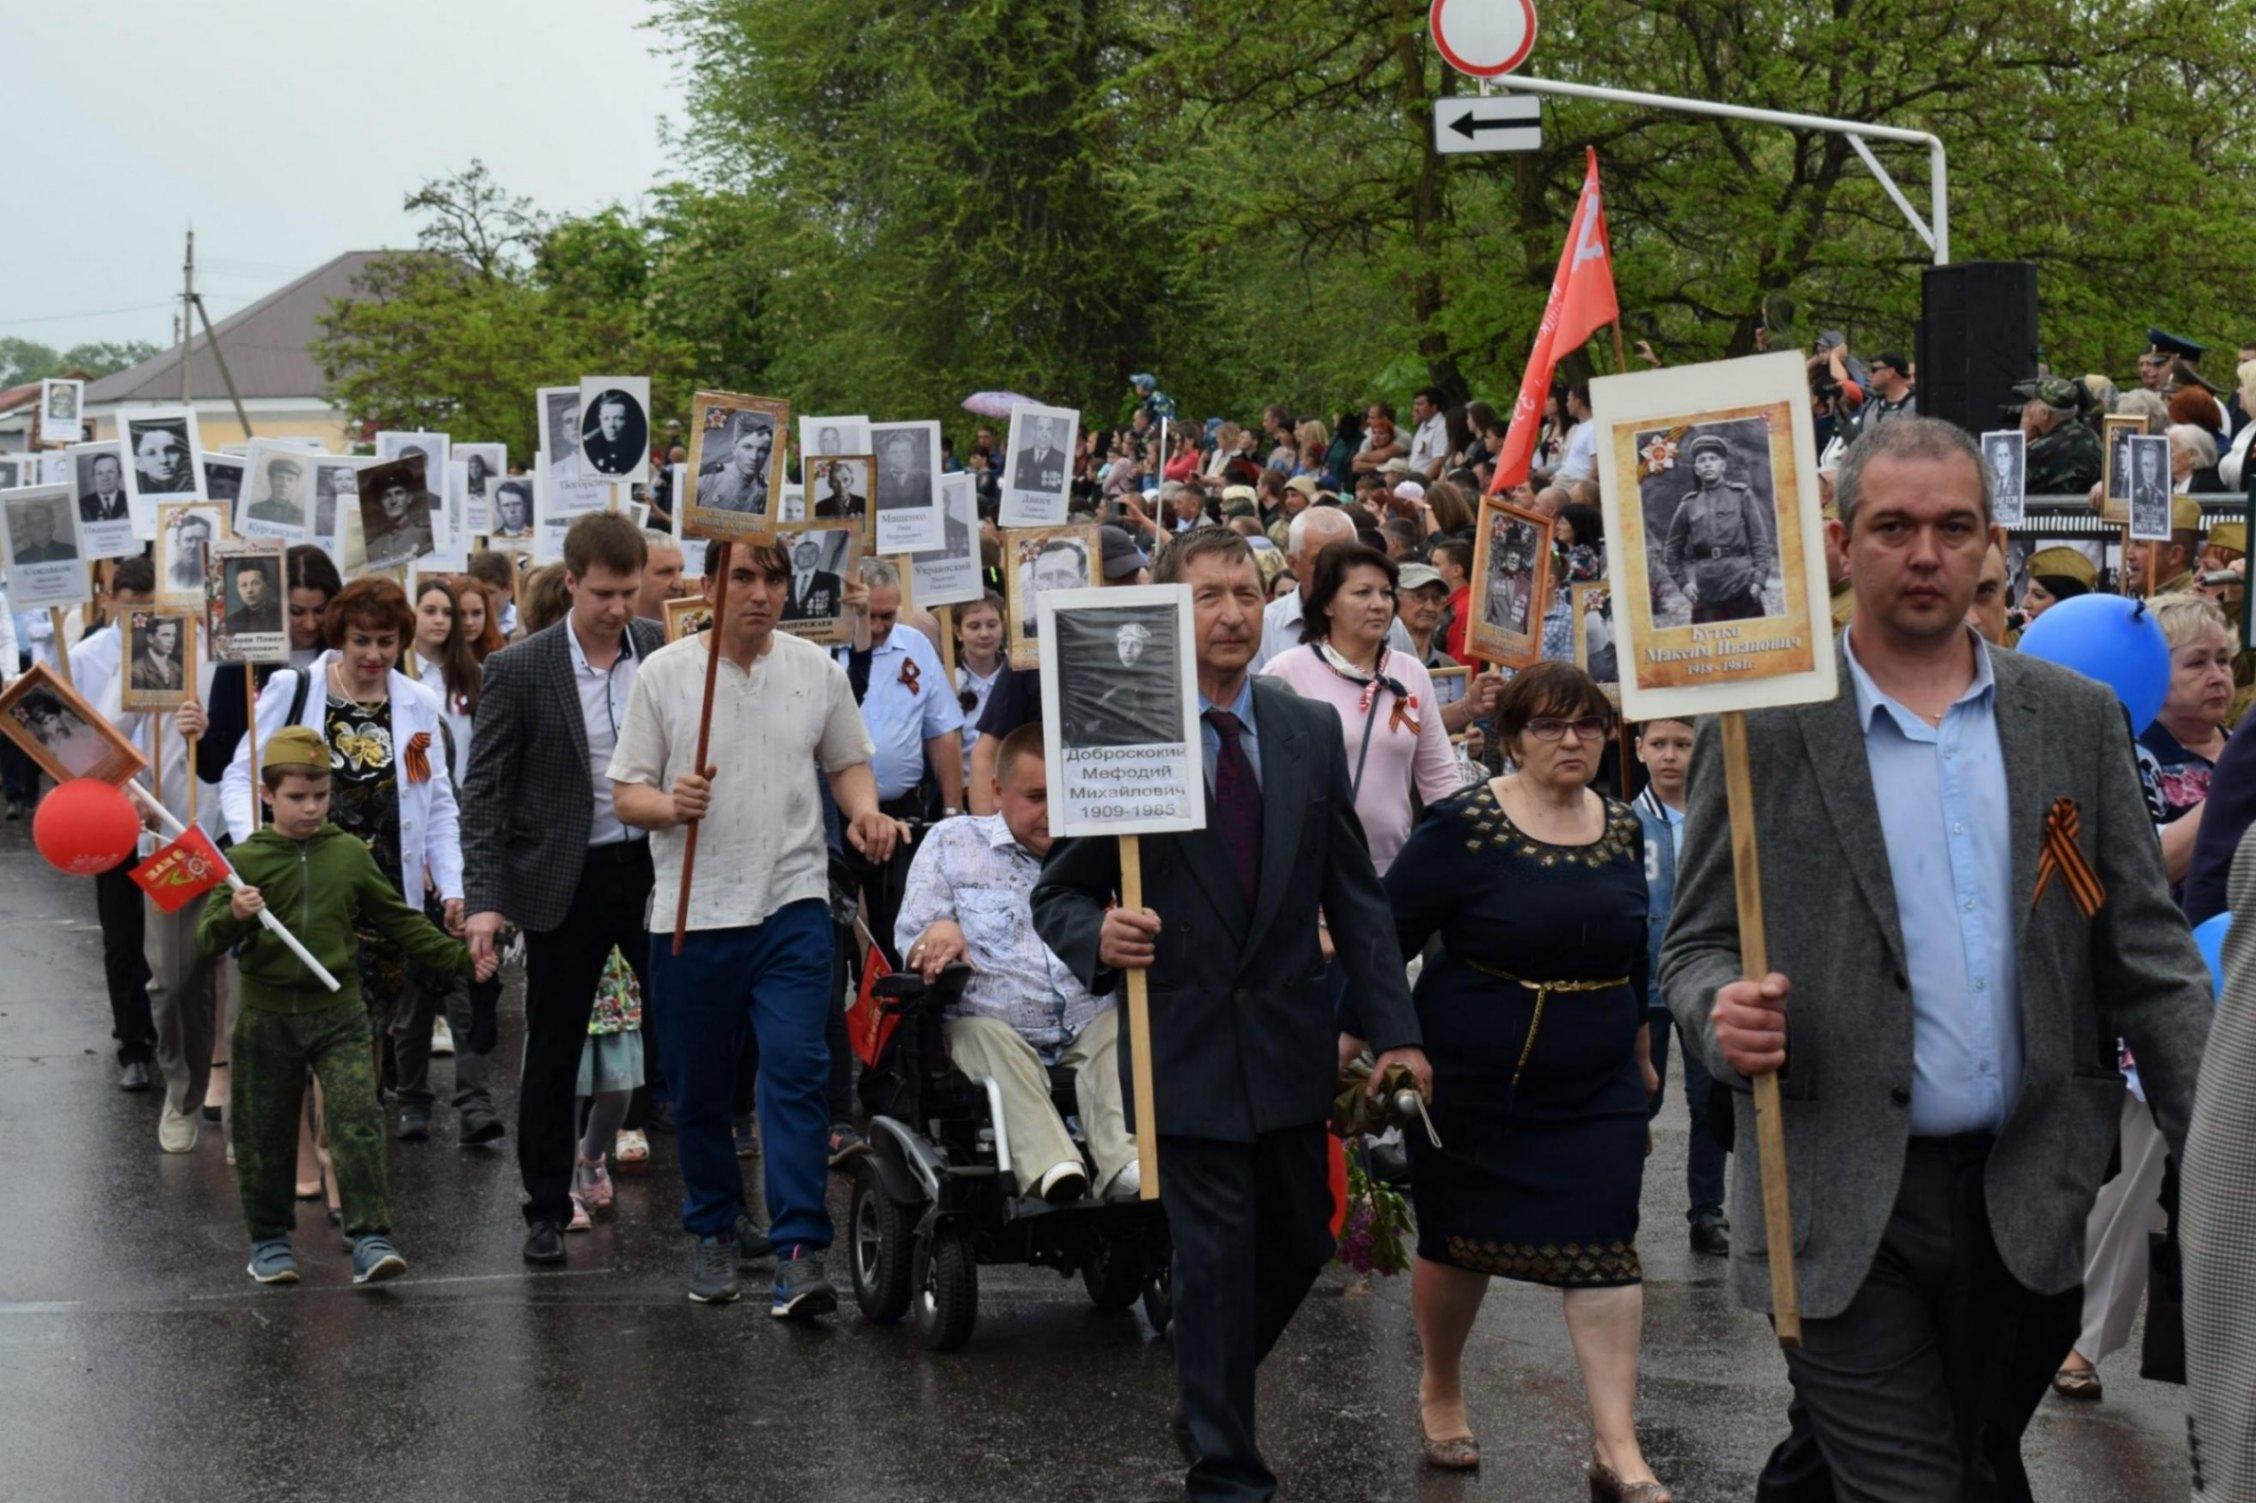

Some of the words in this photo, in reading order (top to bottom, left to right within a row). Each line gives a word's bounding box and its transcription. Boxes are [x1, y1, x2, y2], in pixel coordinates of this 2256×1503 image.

[1644, 646, 1713, 664] Максим
[1716, 636, 1802, 657] Иванович
[1066, 748, 1186, 763] Доброскокин
[1082, 765, 1172, 781] Мефодий
[1070, 786, 1185, 799] Михайлович
[1081, 803, 1176, 818] 1909-1985
